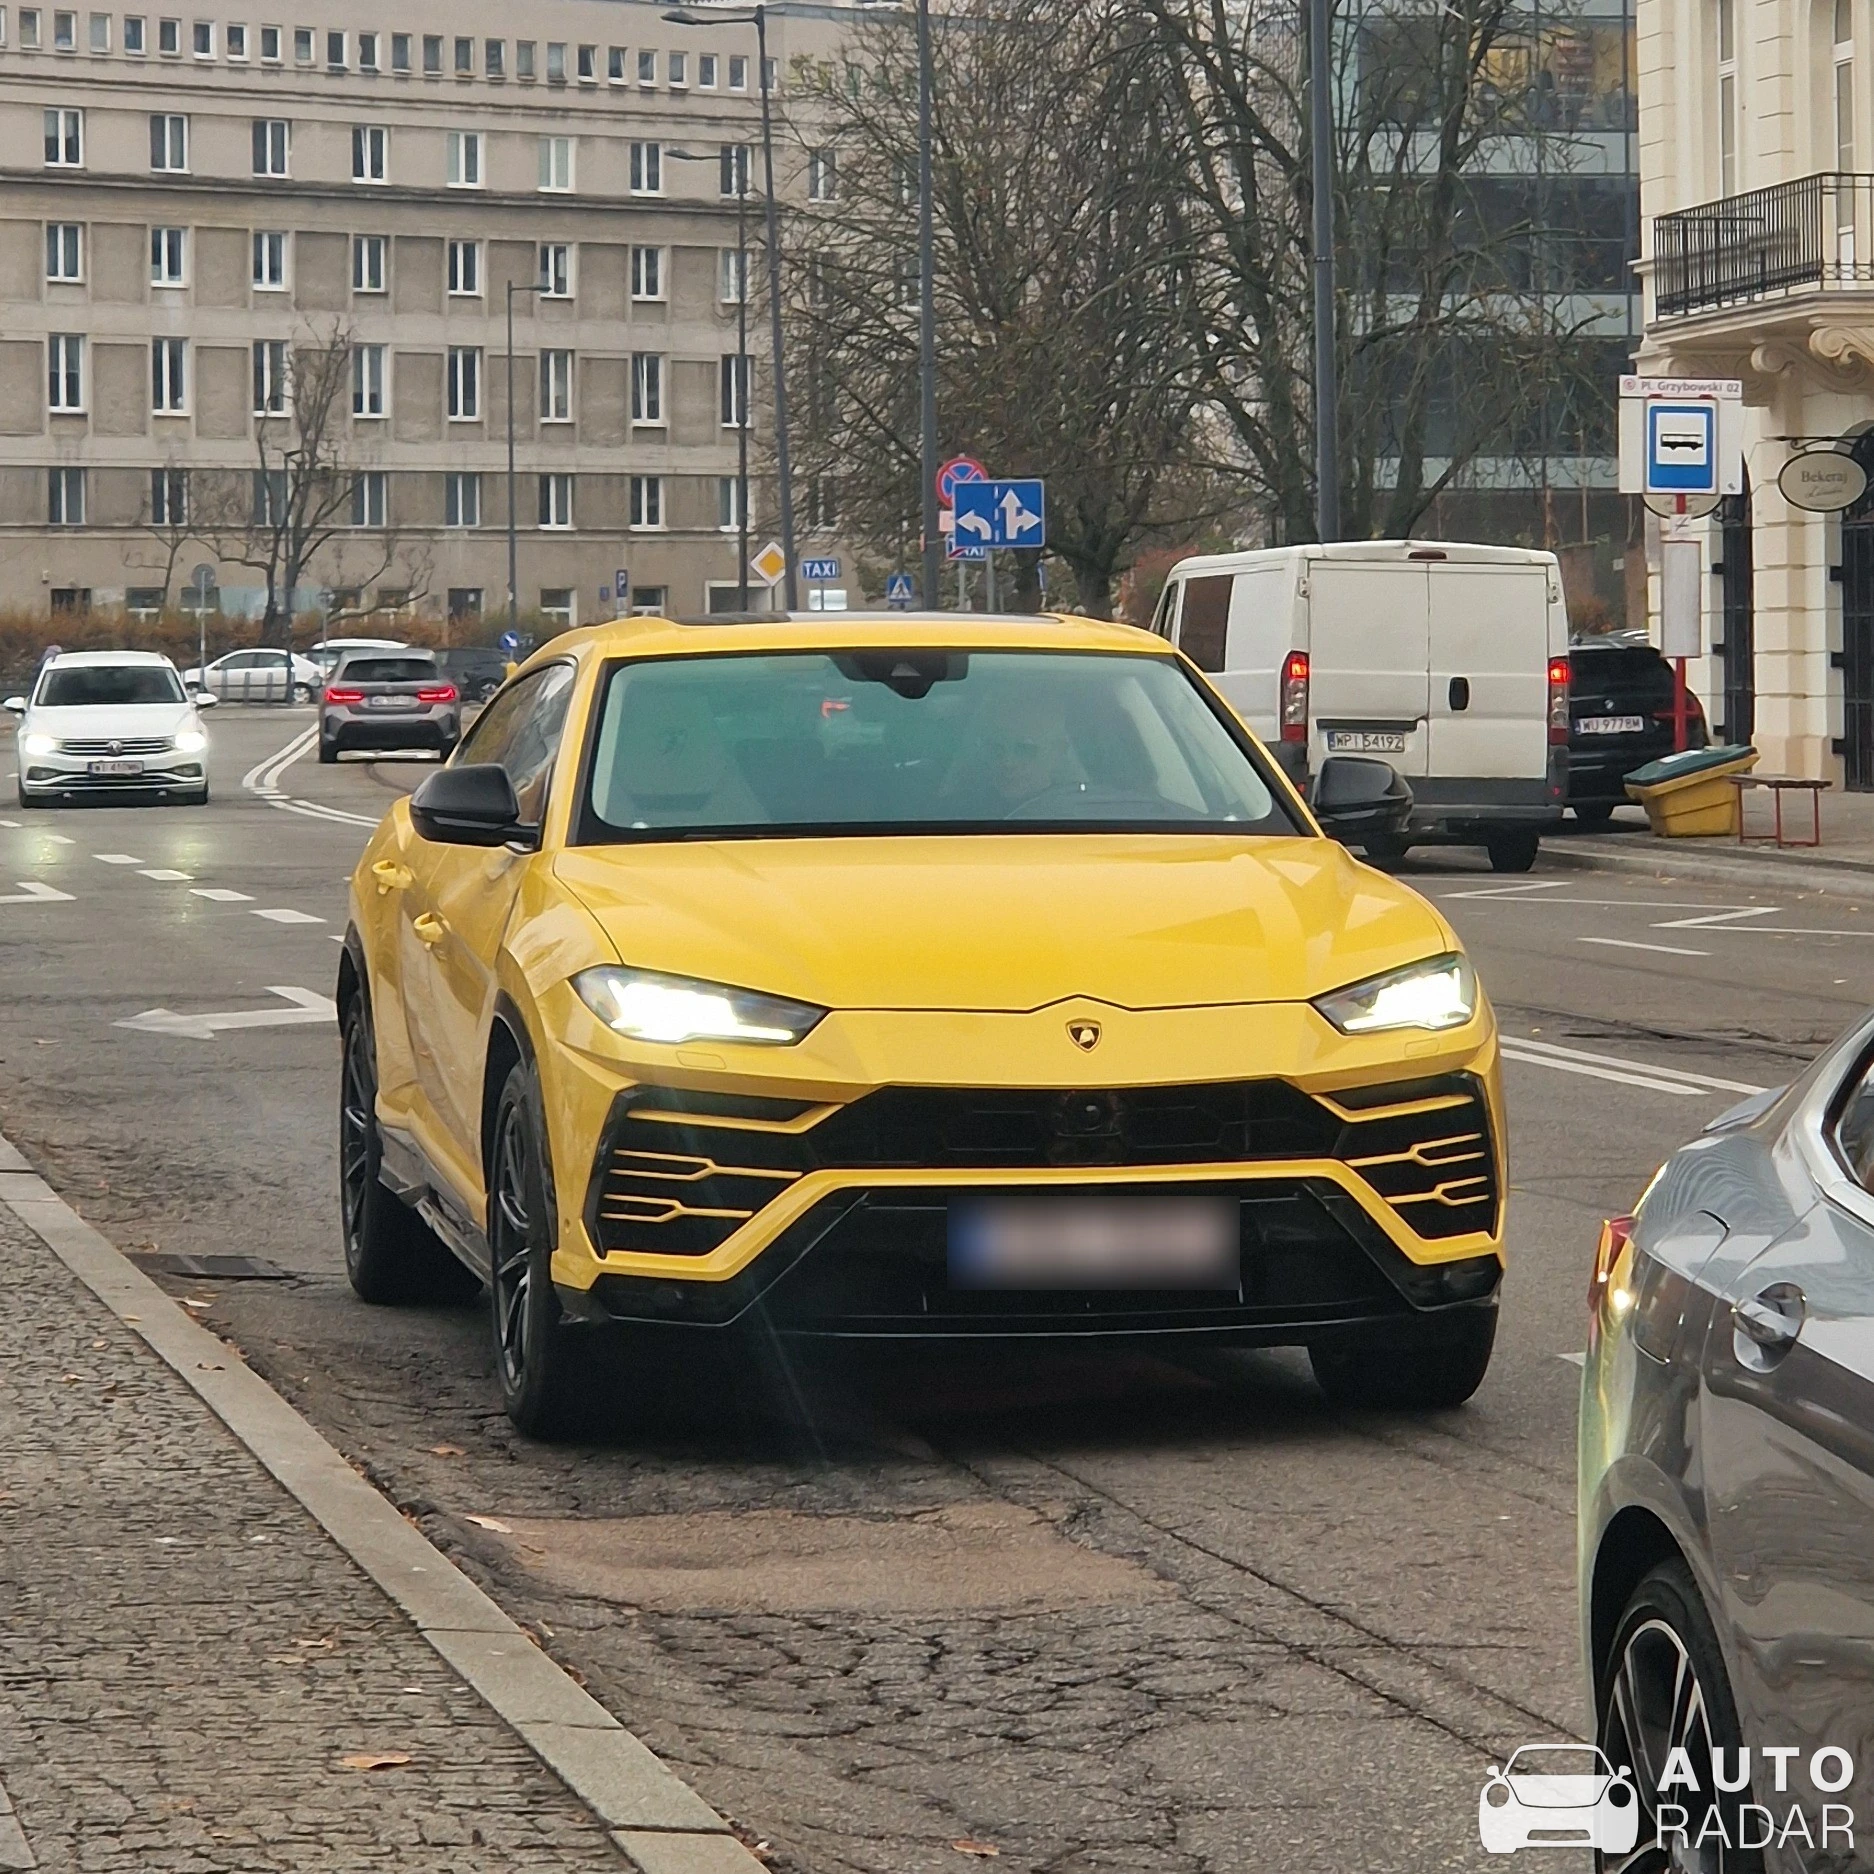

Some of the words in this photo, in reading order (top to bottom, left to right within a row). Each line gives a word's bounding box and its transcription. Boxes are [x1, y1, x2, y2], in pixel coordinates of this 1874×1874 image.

[1657, 381, 1722, 393] Grzybowski
[1726, 384, 1740, 392] 02
[803, 562, 836, 577] TAXI
